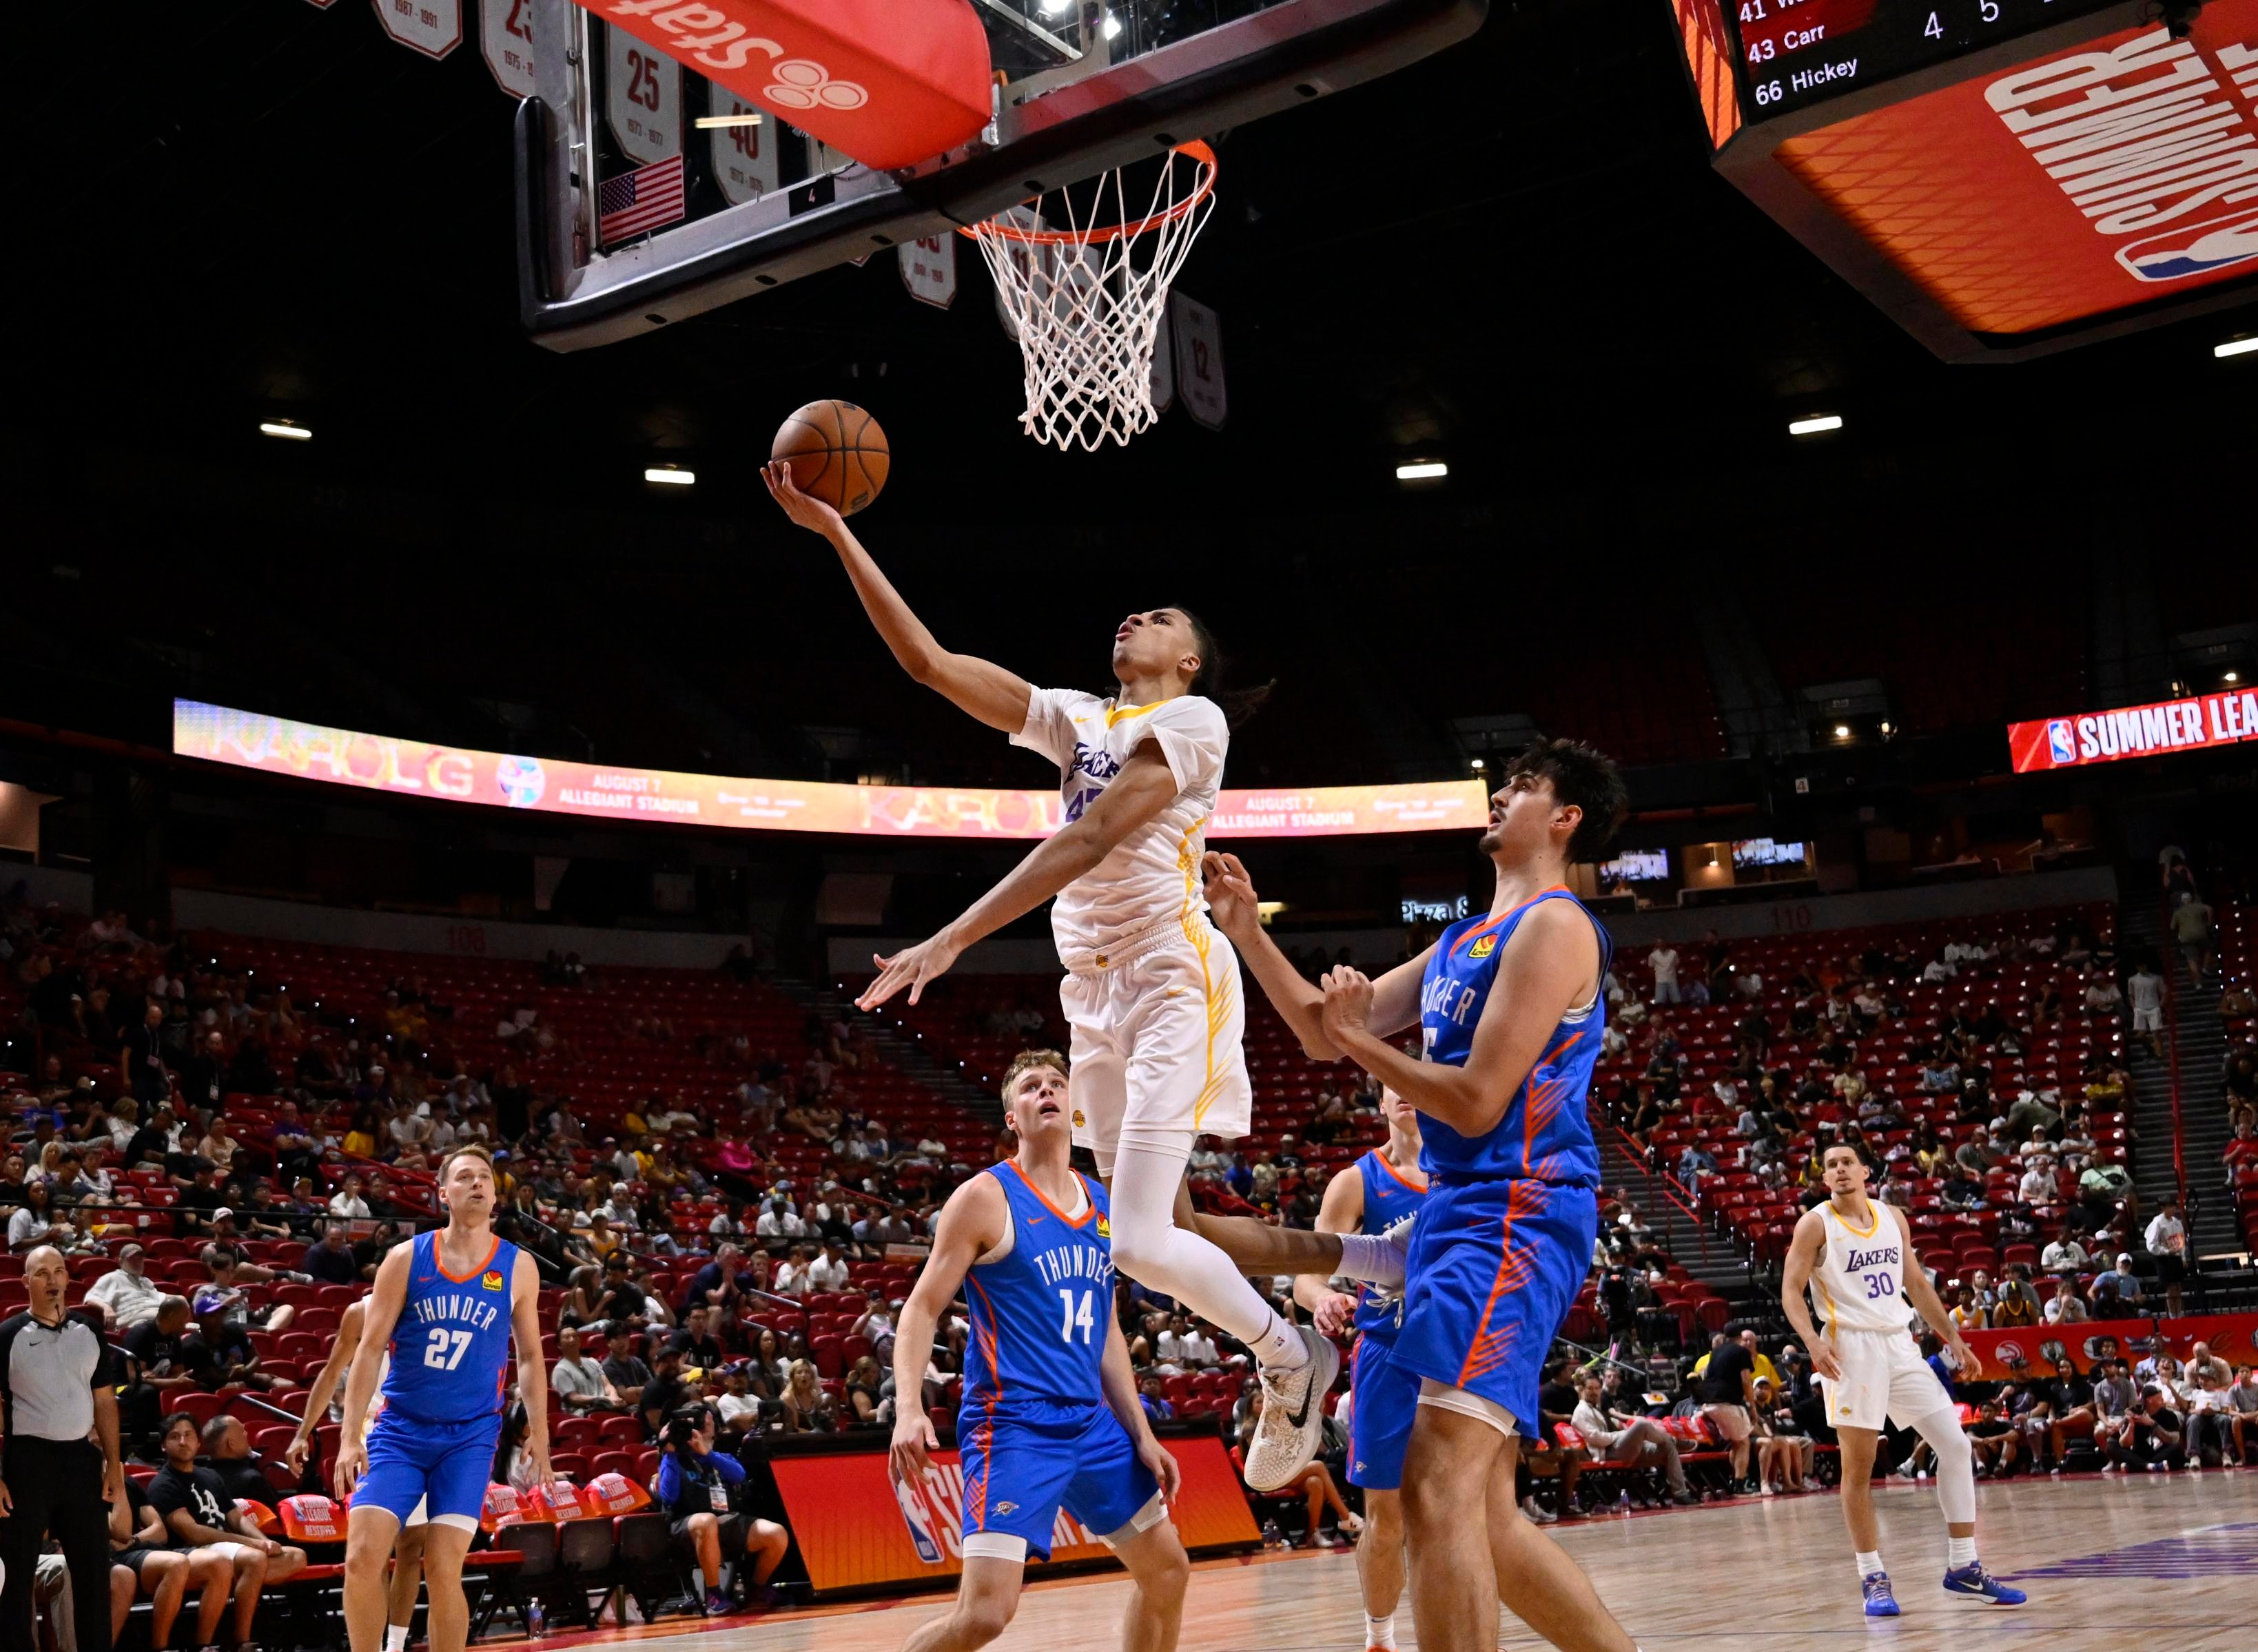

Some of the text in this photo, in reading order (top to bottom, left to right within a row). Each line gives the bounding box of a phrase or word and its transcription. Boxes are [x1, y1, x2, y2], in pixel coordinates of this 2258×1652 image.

[420, 8, 438, 29] 1991
[1740, 0, 1766, 23] 41
[1925, 11, 1944, 39] 4
[1748, 24, 1825, 63] 43 Carr
[628, 48, 660, 112] 25
[1755, 59, 1858, 106] 66 Hickey
[2078, 701, 2206, 758] SUMMER
[593, 773, 662, 793] AUGUST 7
[559, 787, 633, 810] ALLEGIANT
[636, 796, 699, 815] STADIUM
[1246, 796, 1315, 812] AUGUST 7
[1212, 811, 1355, 829] ALLEGIANT STADIUM
[1034, 1244, 1115, 1289] THUNDER
[1843, 1246, 1899, 1273] LAKERS
[1863, 1272, 1895, 1299] 30
[414, 1294, 497, 1331] THUNDER
[1059, 1288, 1094, 1345] 14
[424, 1328, 473, 1371] 27
